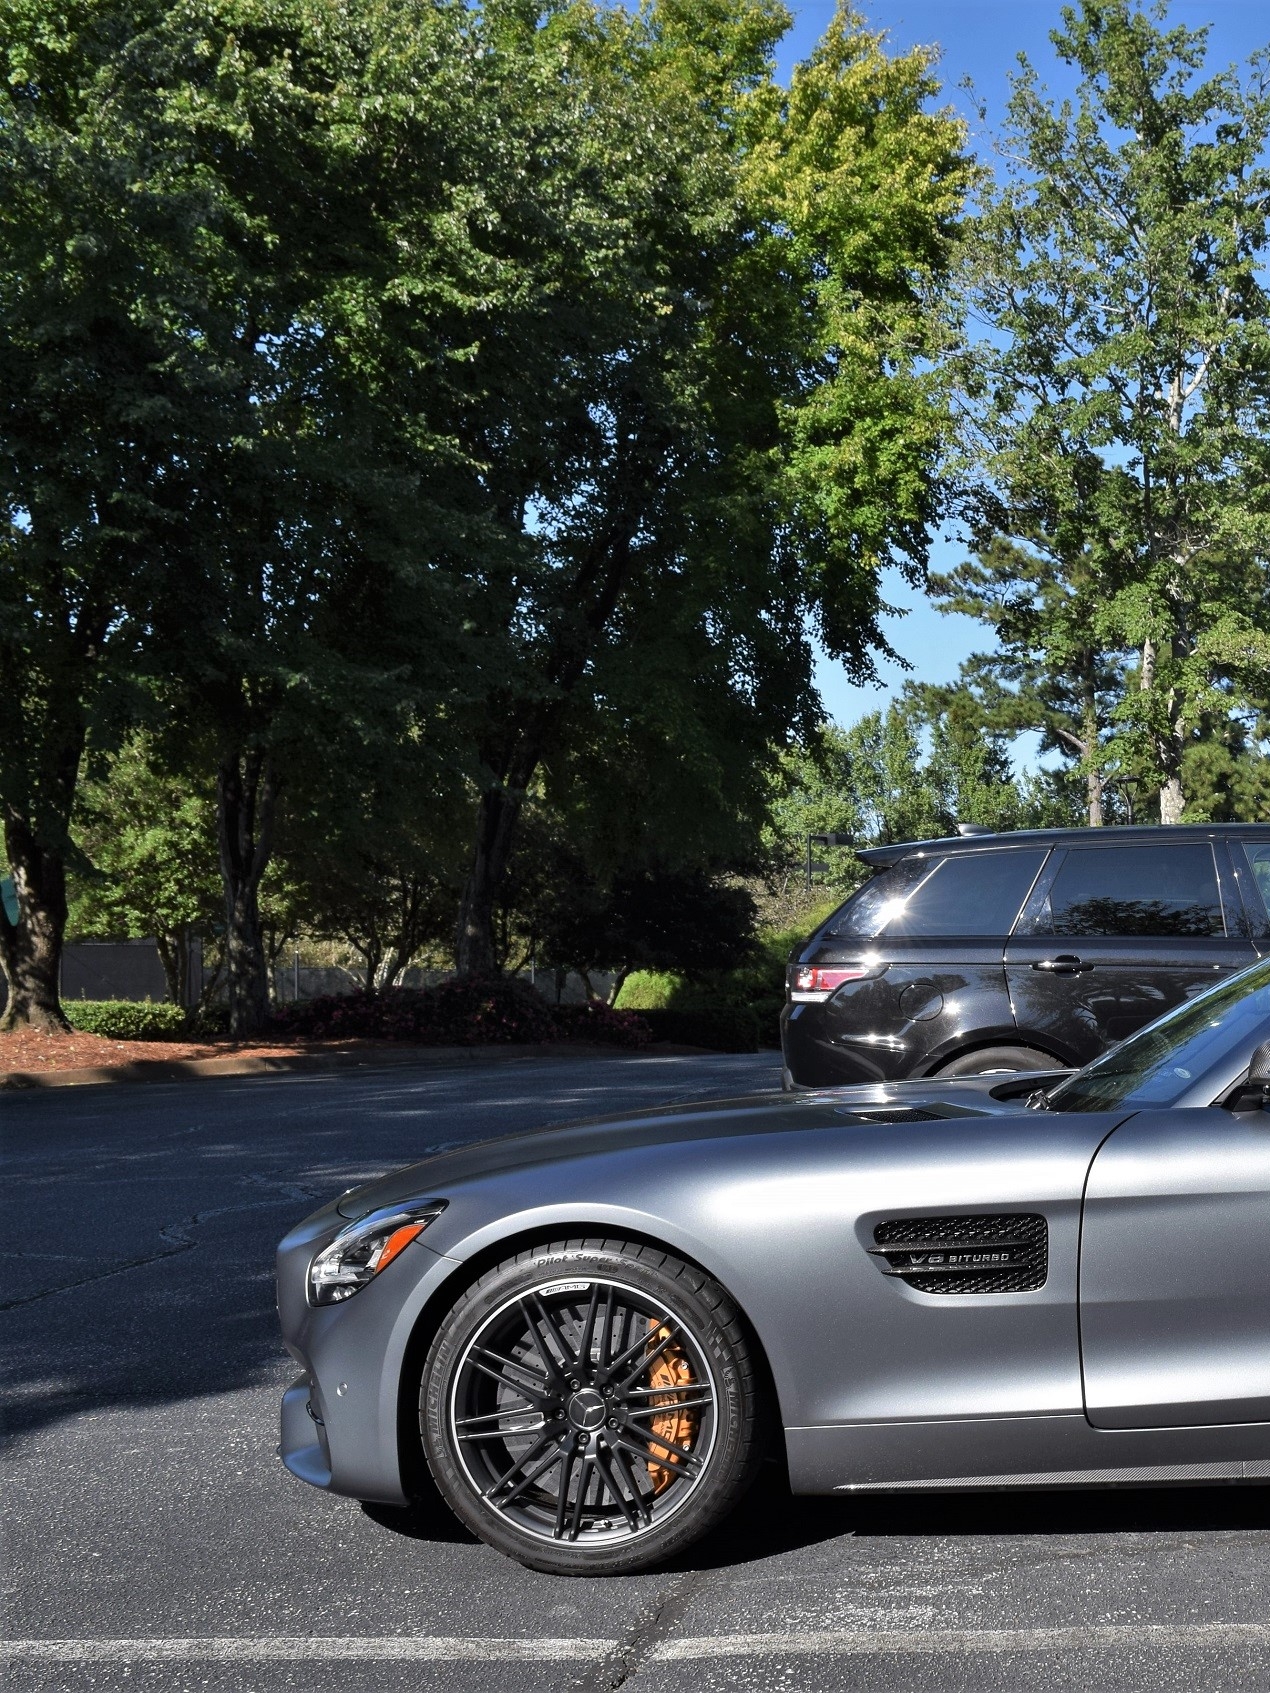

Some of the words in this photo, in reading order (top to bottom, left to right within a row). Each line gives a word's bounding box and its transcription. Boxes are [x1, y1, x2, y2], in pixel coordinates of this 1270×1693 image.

[537, 1255, 568, 1268] Pilot
[575, 1253, 613, 1264] Super
[909, 1253, 945, 1264] V8
[948, 1253, 1010, 1263] BITURBO
[427, 1340, 455, 1434] MICHELIN
